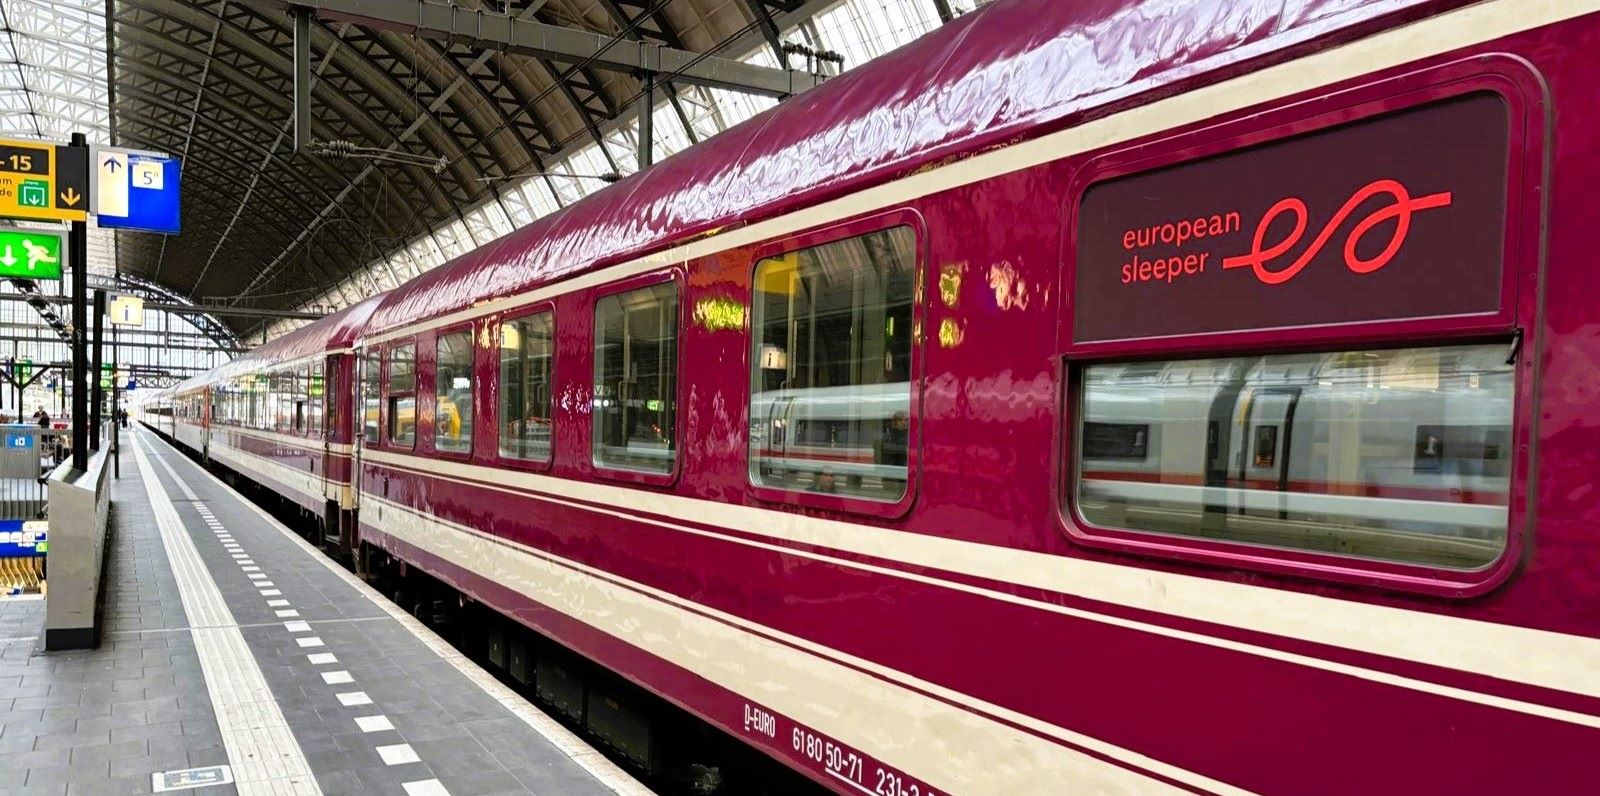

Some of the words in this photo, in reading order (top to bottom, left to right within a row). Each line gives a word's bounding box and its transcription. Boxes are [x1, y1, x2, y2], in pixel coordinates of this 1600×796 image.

[9, 154, 32, 171] 15
[1122, 211, 1241, 249] european
[1121, 250, 1209, 284] sleeper
[744, 703, 776, 738] D-EURO
[825, 741, 863, 783] 50-71
